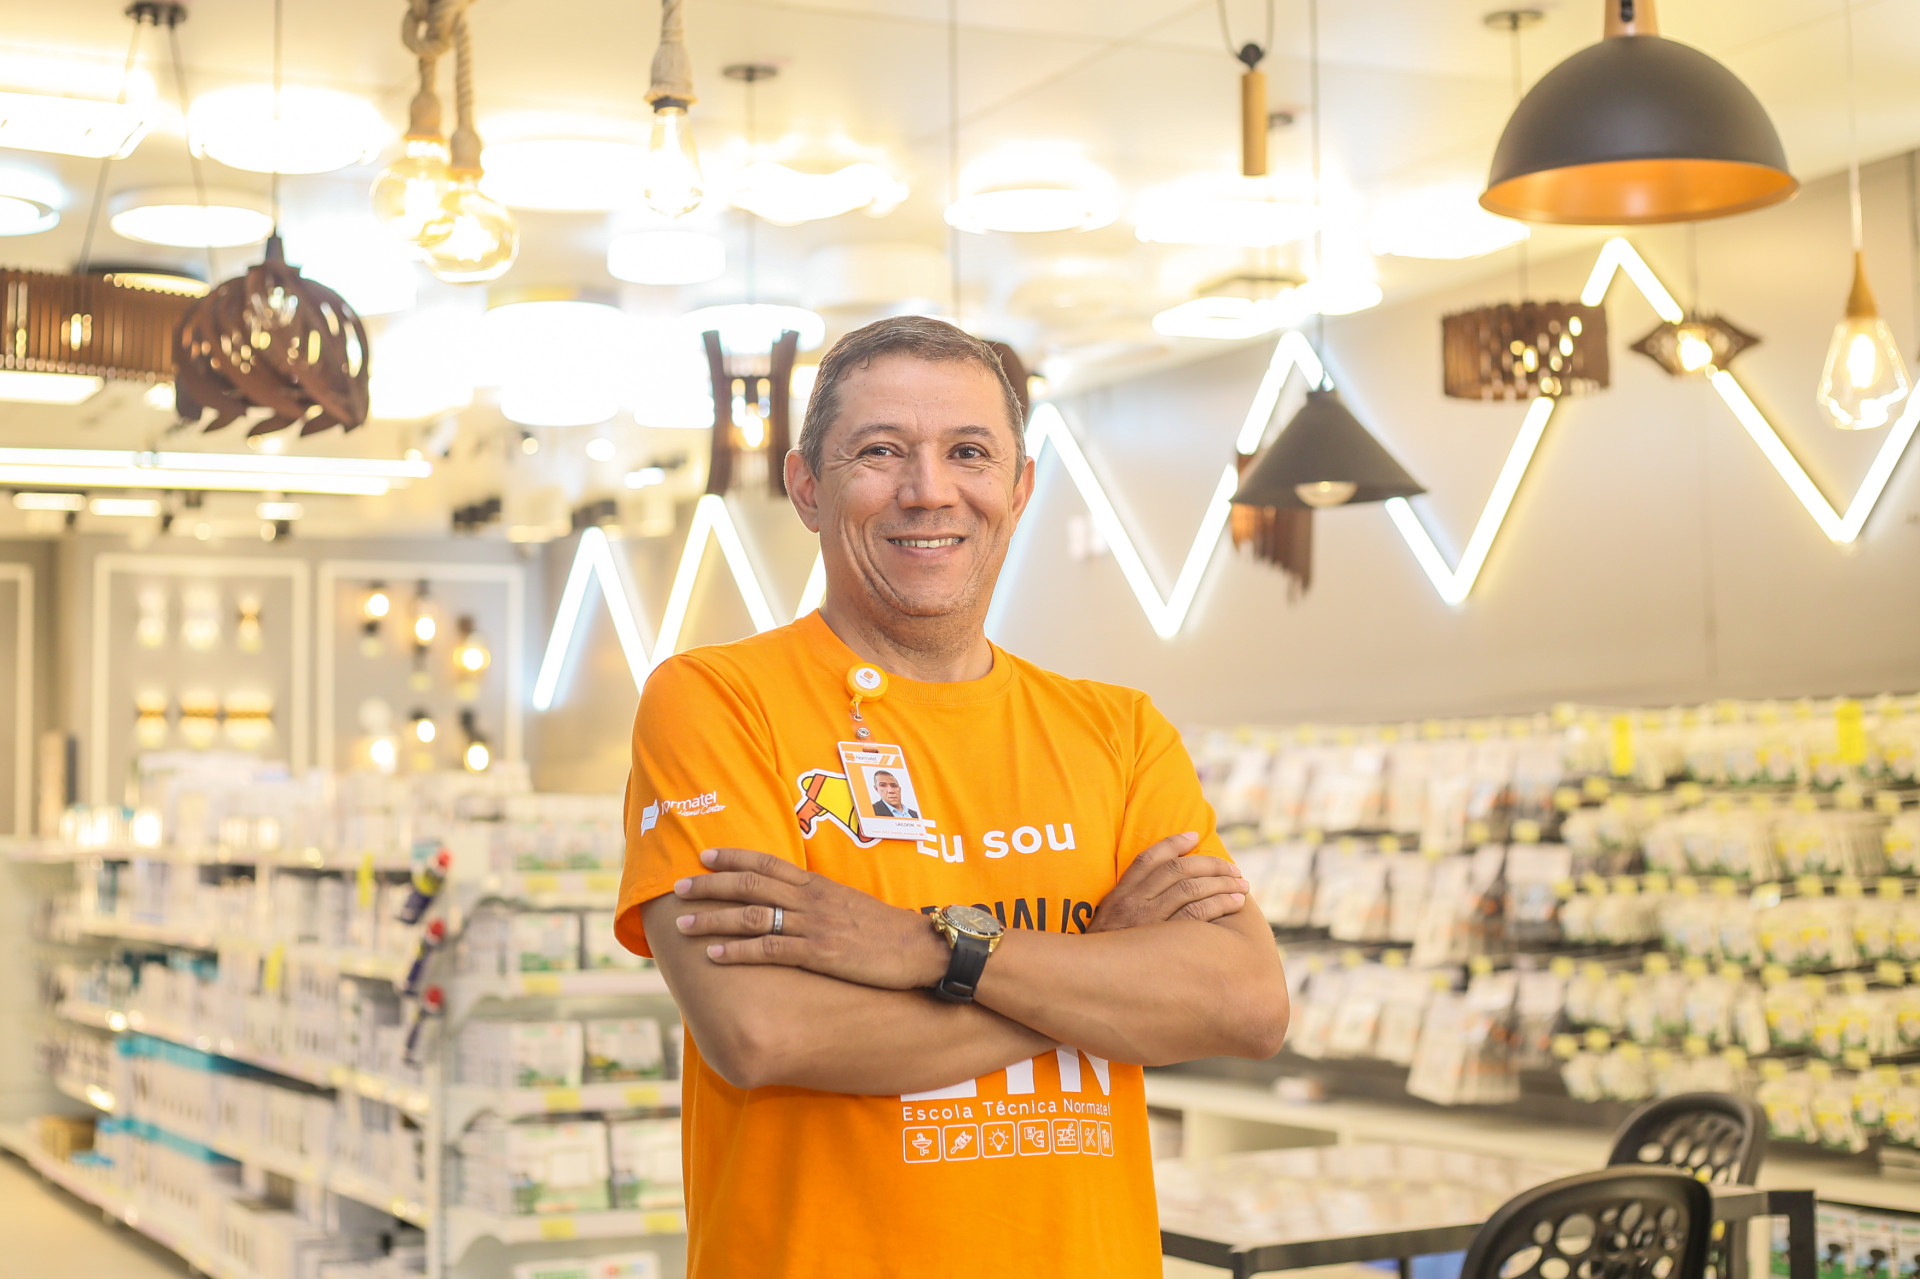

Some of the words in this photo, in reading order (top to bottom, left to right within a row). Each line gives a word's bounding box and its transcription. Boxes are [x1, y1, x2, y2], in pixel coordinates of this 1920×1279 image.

[916, 818, 965, 863] Eu
[982, 823, 1076, 859] sou
[902, 1104, 973, 1121] Escola
[982, 1099, 1057, 1117] Técnica
[1063, 1098, 1111, 1117] Normatel
